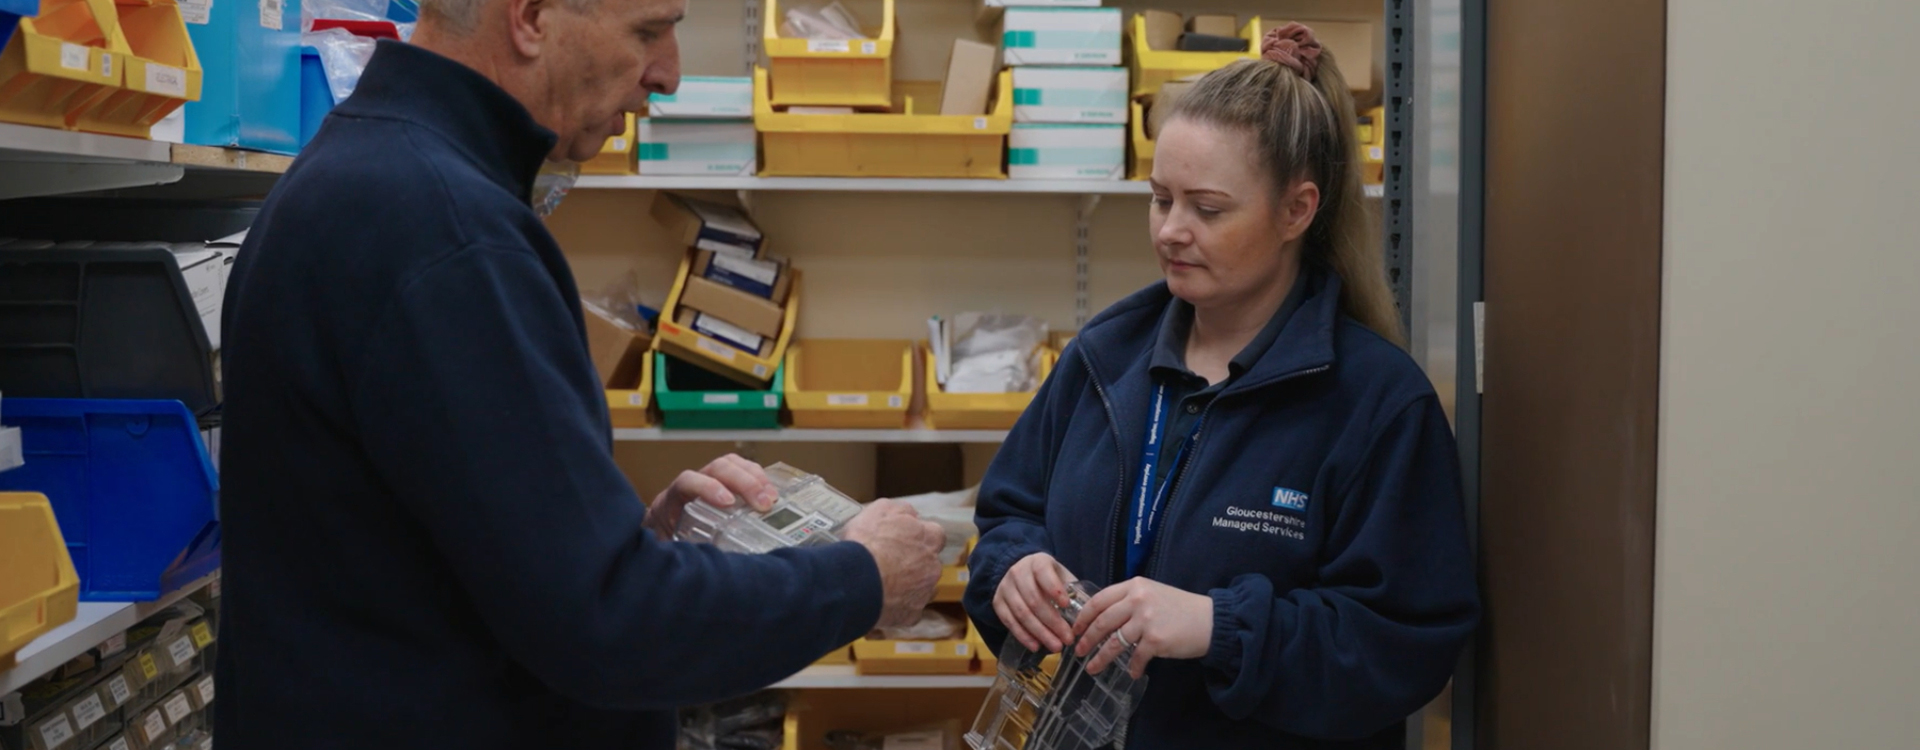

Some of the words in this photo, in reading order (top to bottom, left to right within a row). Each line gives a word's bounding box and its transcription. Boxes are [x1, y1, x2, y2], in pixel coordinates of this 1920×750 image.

[1138, 486, 1146, 517] exceptional
[1143, 463, 1152, 486] everyday
[1274, 488, 1308, 509] NHS
[1212, 516, 1260, 532] Managed
[1261, 521, 1305, 540] Services
[1226, 505, 1306, 528] Gloucestershire
